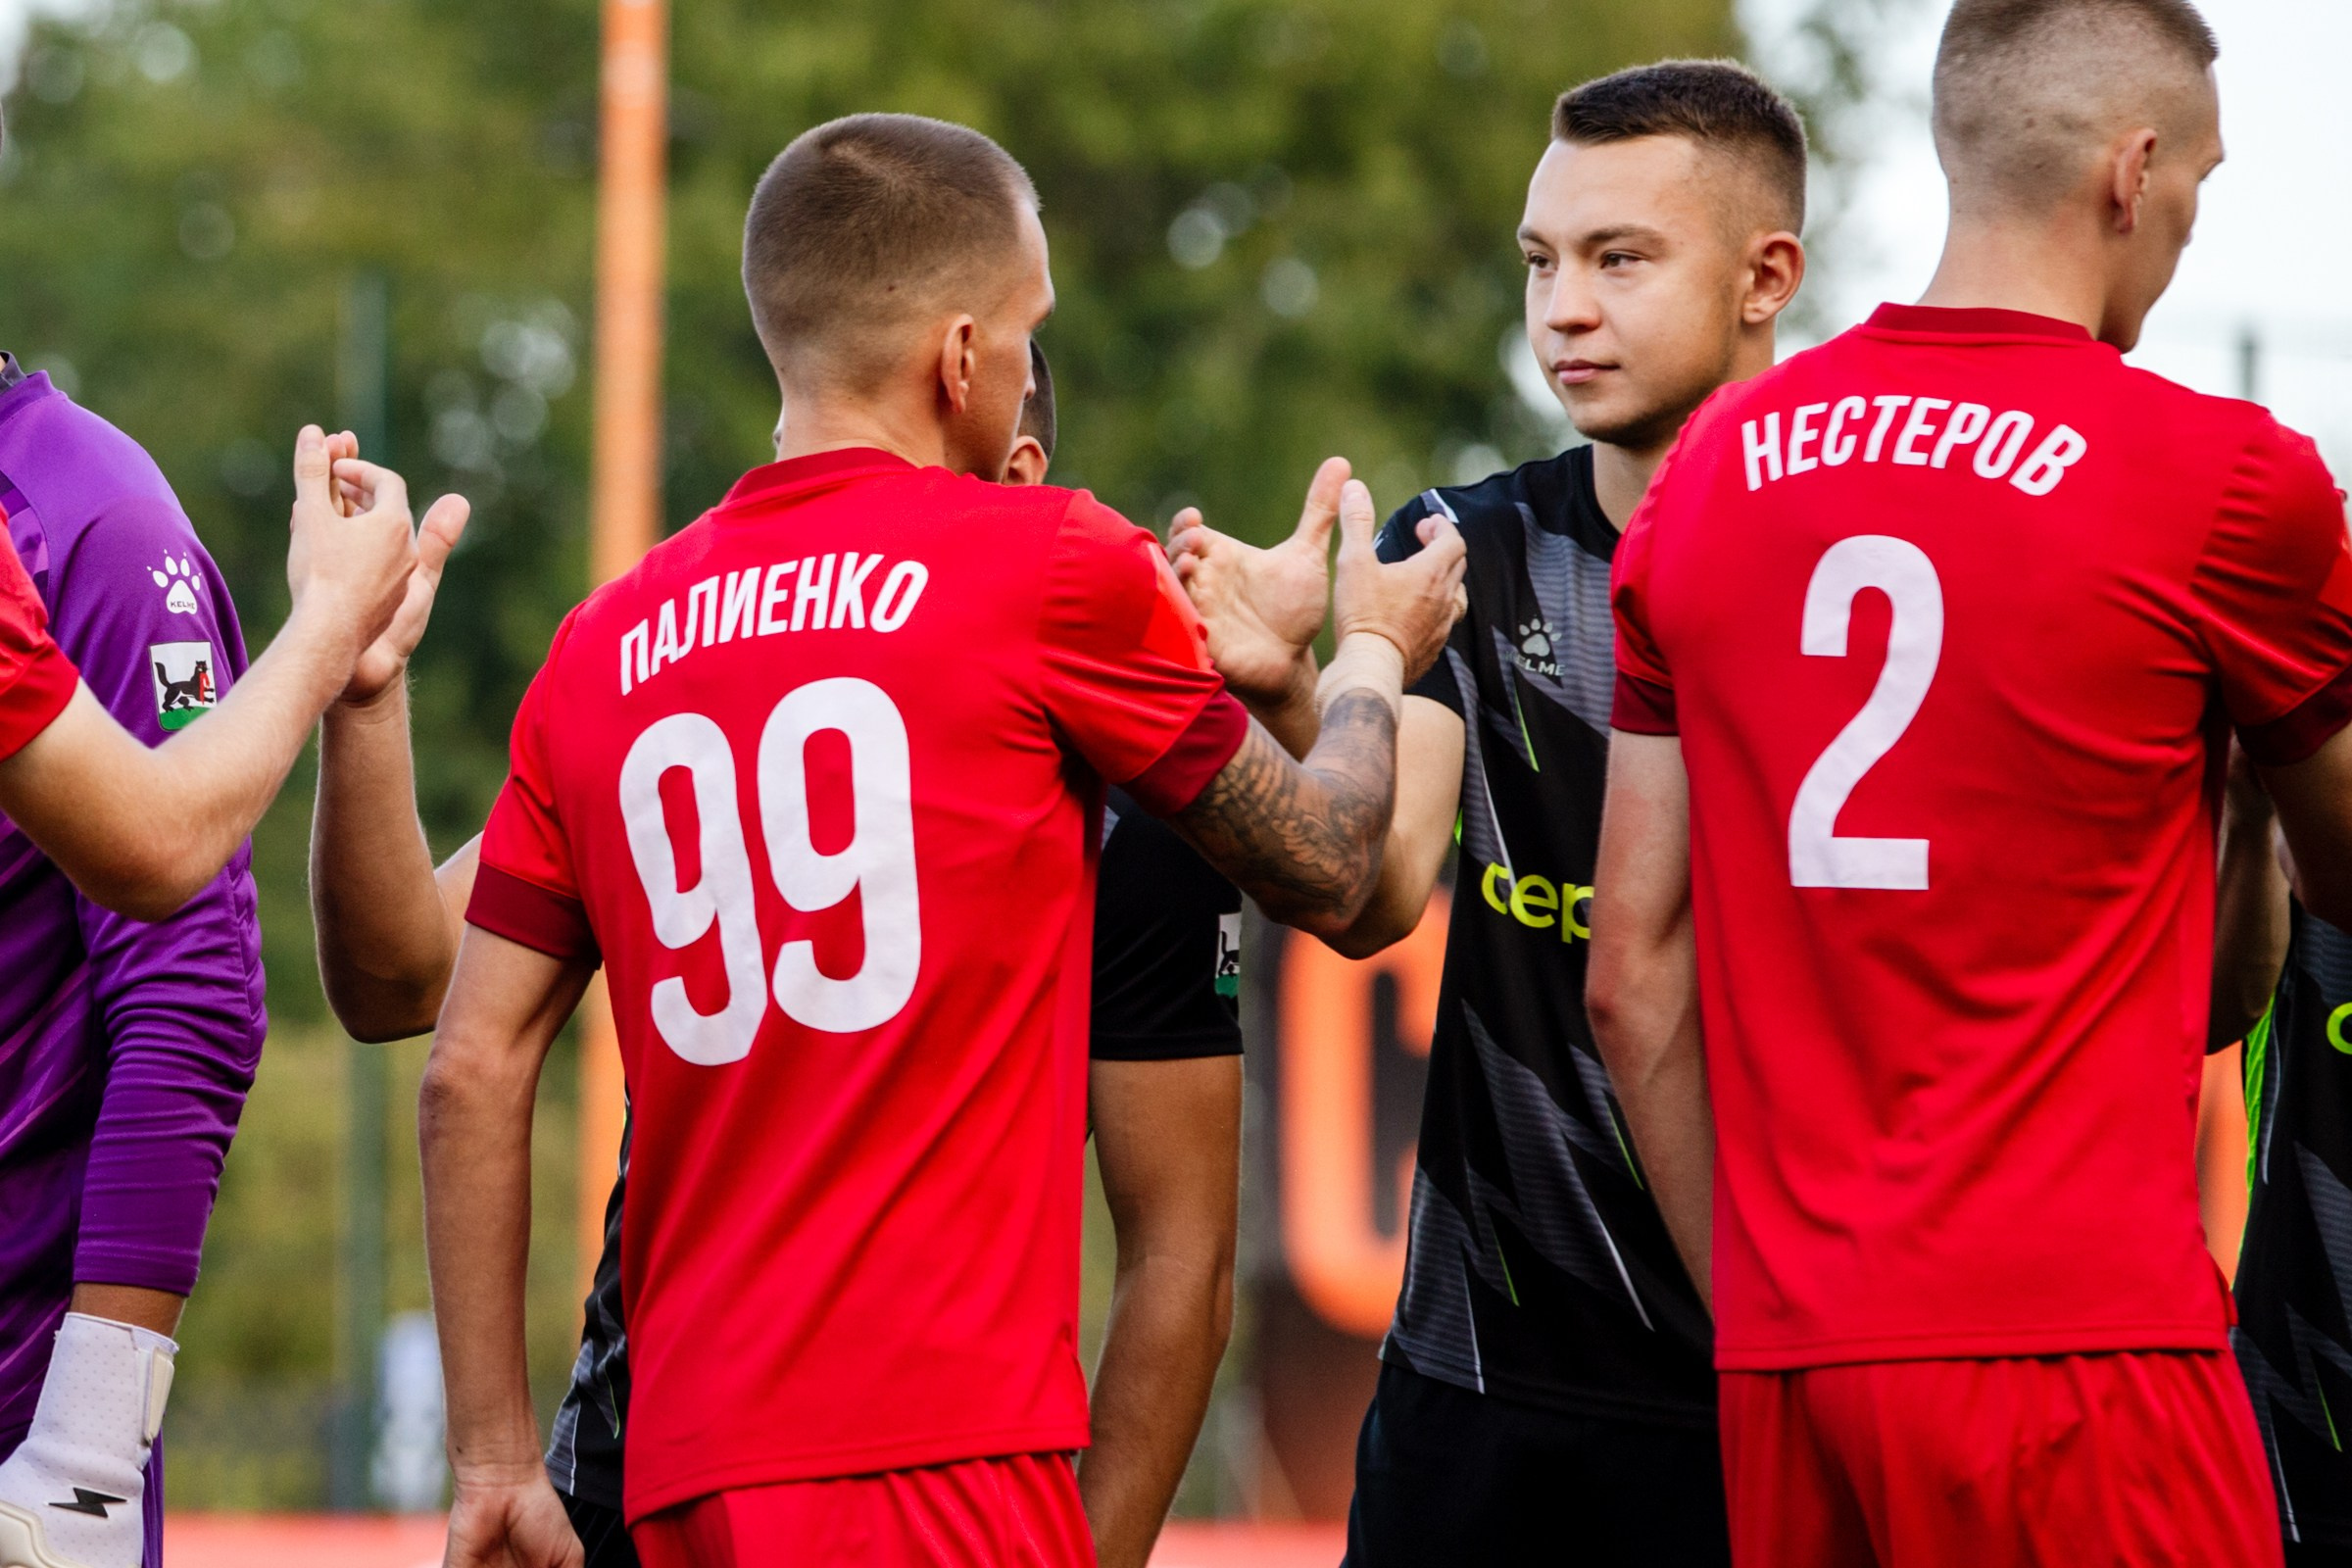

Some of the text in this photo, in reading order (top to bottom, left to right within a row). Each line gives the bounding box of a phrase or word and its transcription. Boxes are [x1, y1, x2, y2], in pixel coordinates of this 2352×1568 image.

[1741, 395, 2087, 496] НЕСТЕРОВ
[619, 552, 929, 696] ПАЛИЕНКО
[1506, 651, 1566, 676] ELME
[1788, 534, 1944, 890] 2
[618, 677, 922, 1066] 99
